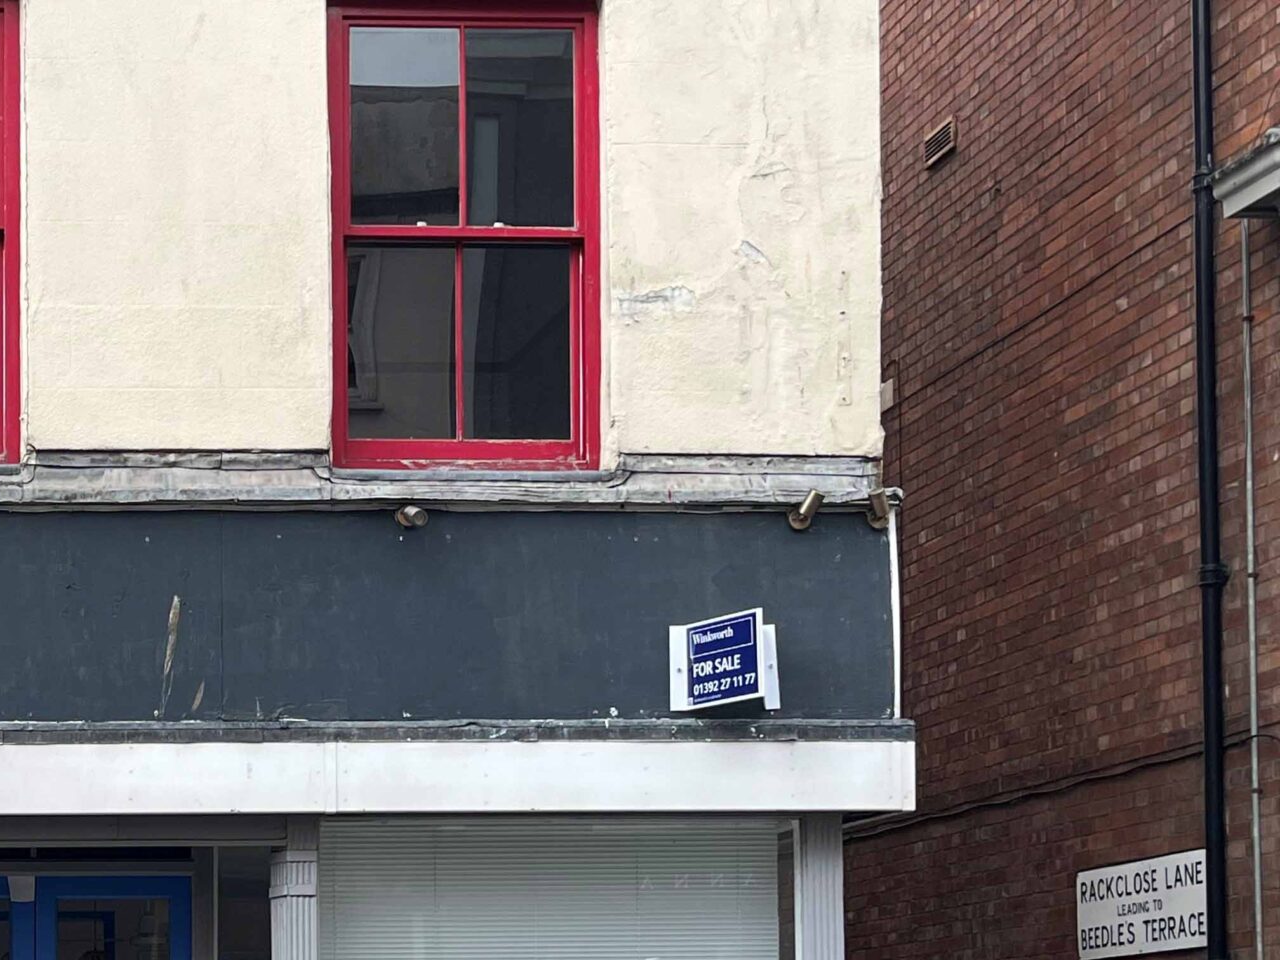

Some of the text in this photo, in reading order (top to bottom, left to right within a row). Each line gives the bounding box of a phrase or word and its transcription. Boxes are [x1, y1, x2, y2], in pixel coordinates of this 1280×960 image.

[692, 626, 734, 645] Winkworth
[693, 654, 741, 678] FOR SALE
[693, 673, 756, 695] 01392 27 11 77
[1080, 861, 1204, 904] RACKCLOSE LANE
[1117, 899, 1163, 917] LEADING TO
[1080, 912, 1206, 951] BEEDLE'S TERRACE
